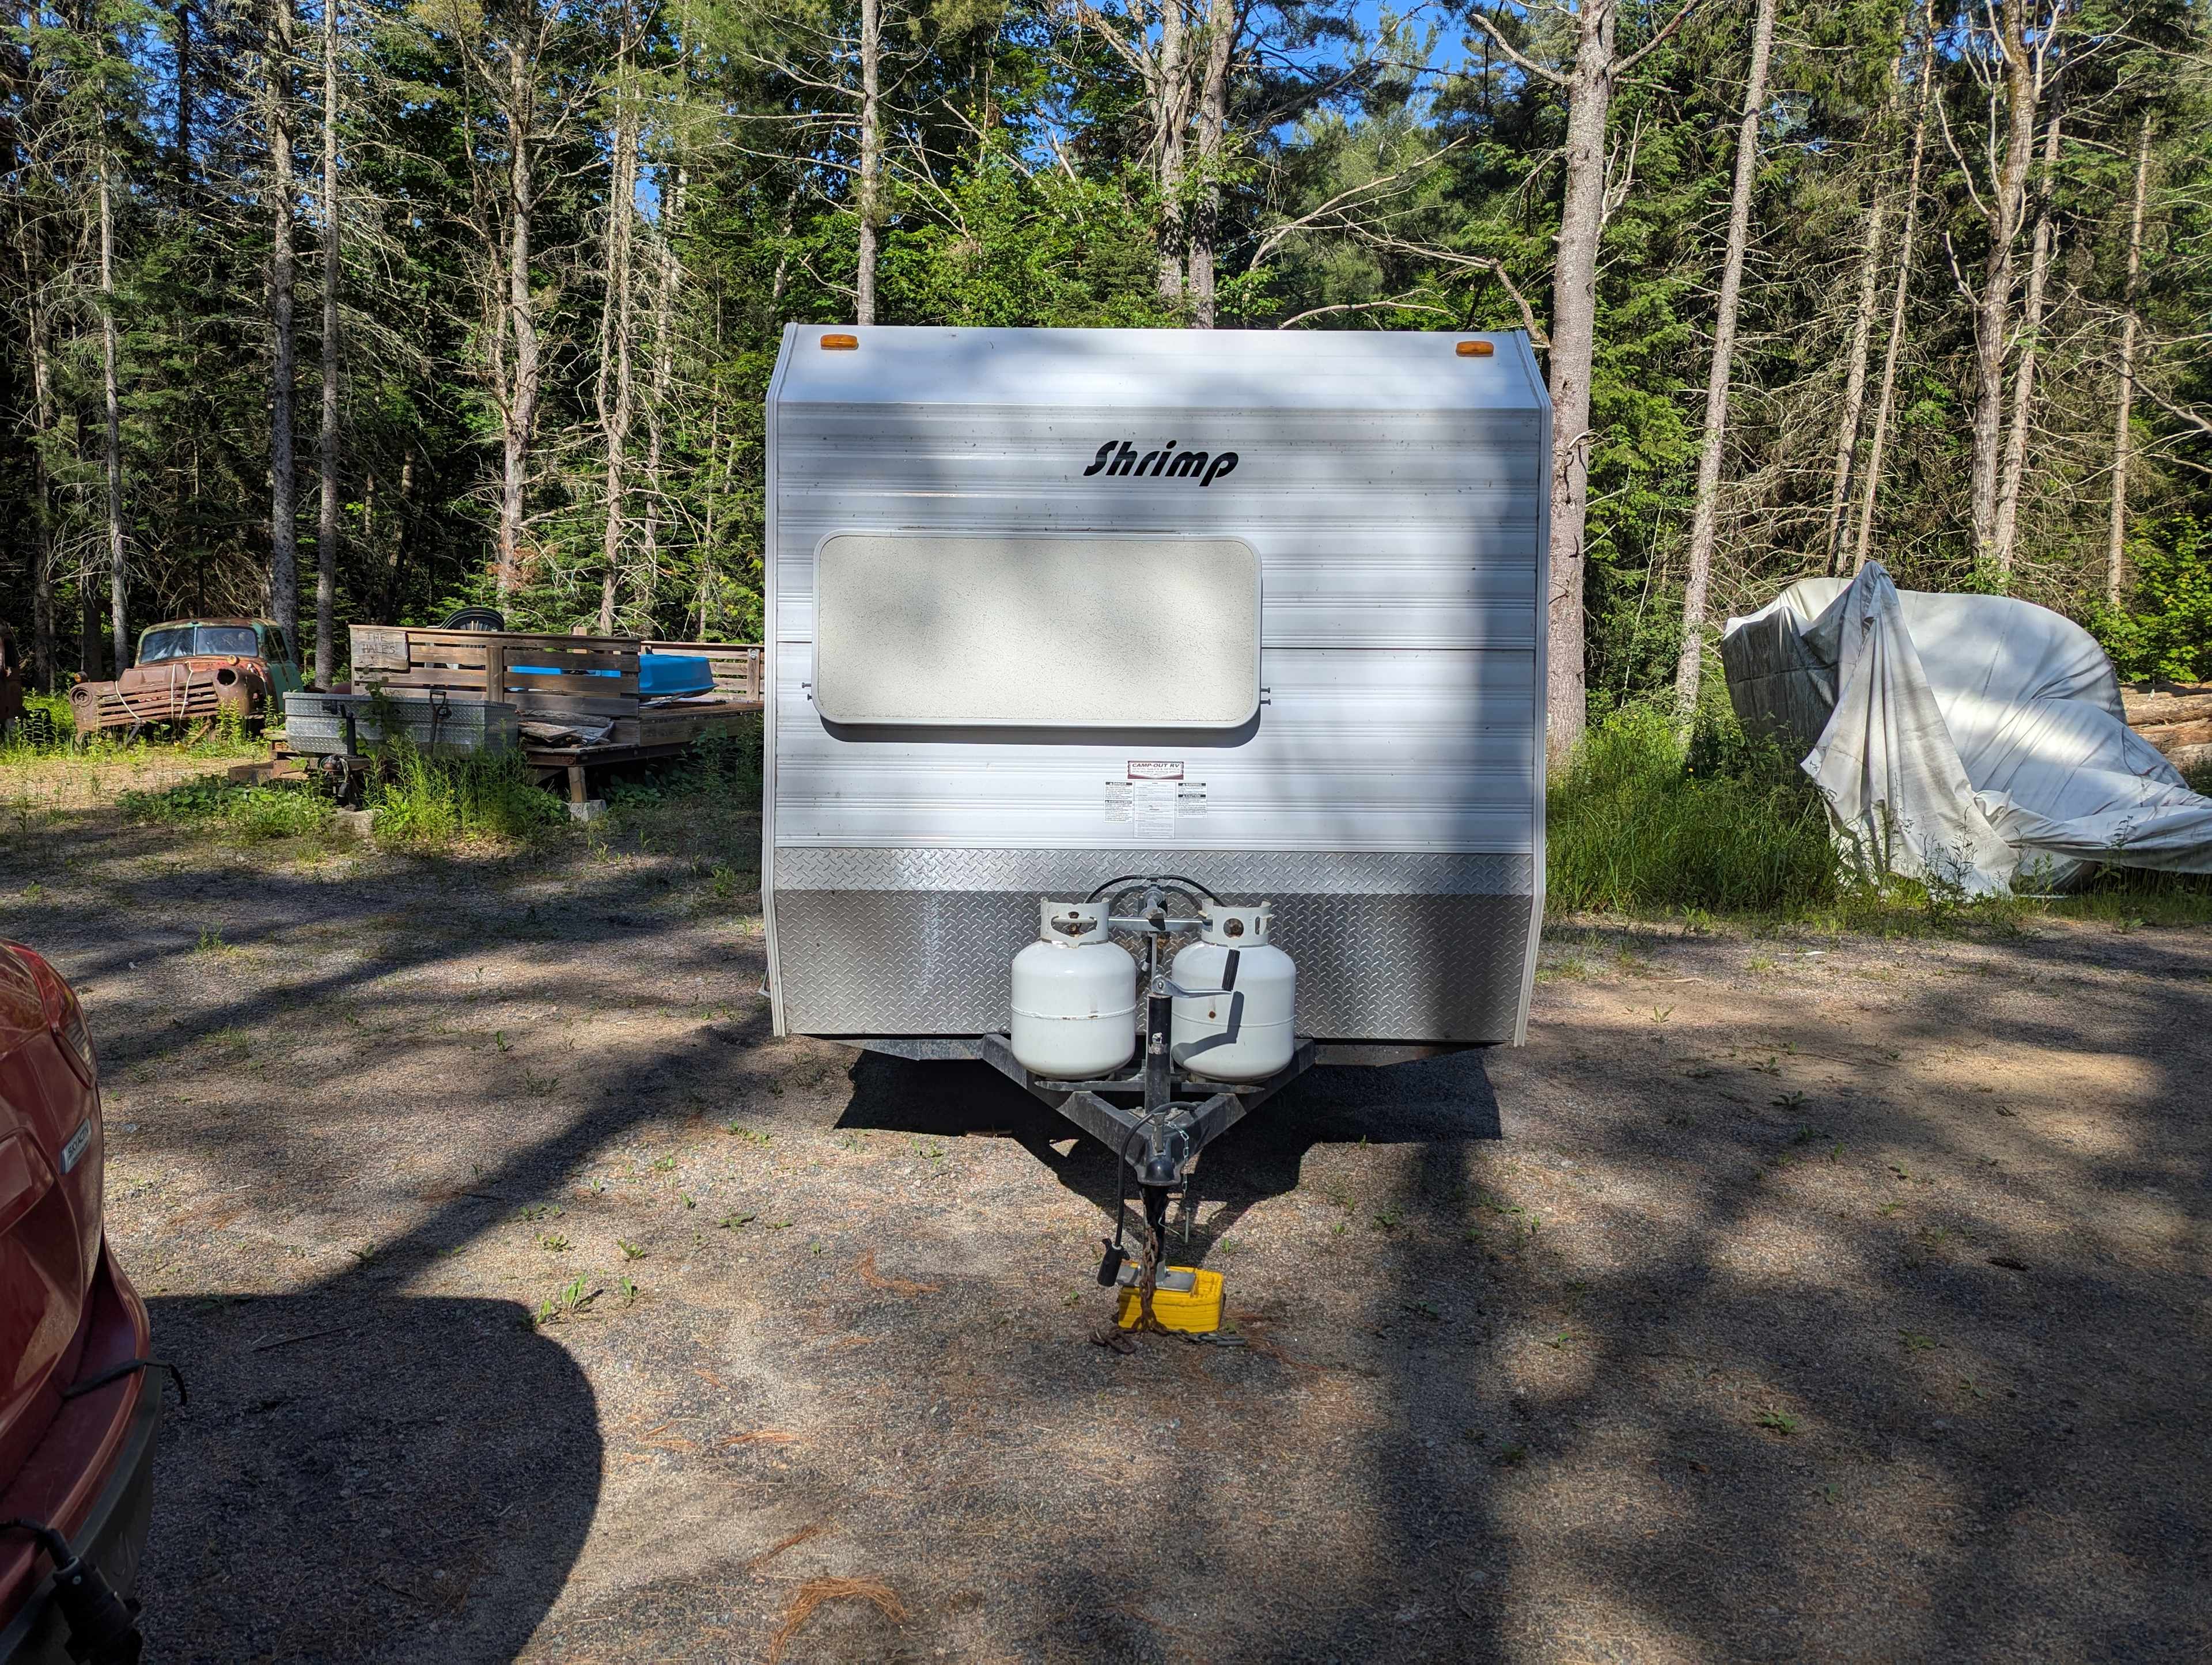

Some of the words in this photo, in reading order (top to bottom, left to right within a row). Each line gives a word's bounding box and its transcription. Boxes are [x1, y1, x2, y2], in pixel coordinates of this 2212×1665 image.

[1083, 440, 1238, 487] Shrimp
[365, 632, 388, 642] THE
[362, 644, 395, 654] HALES
